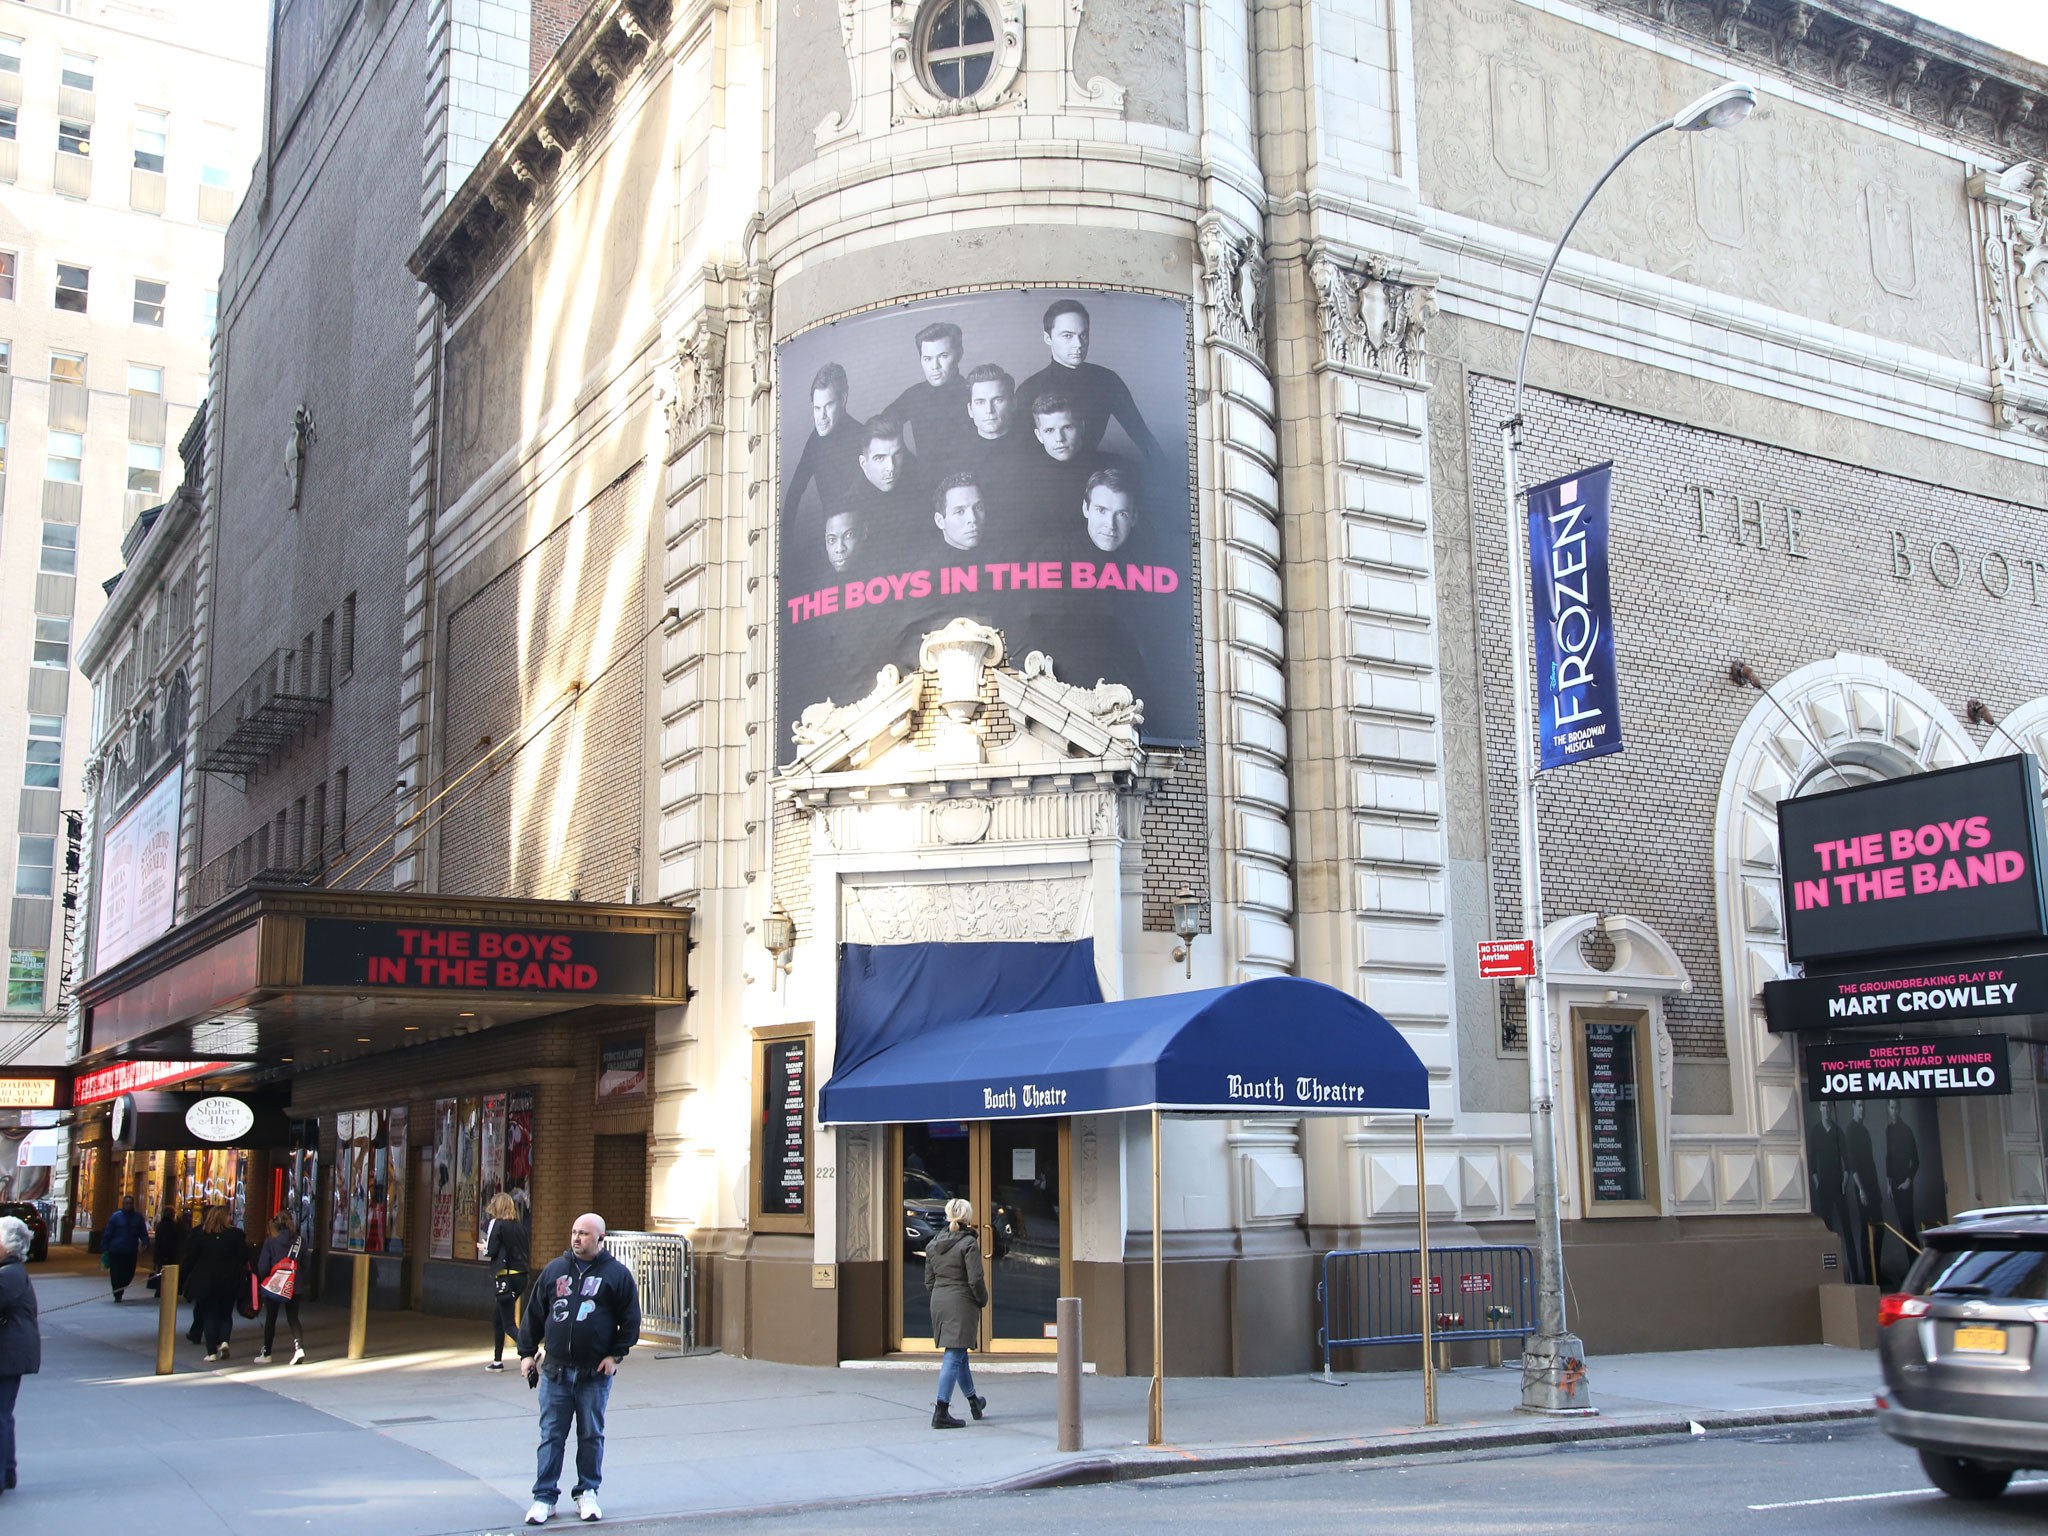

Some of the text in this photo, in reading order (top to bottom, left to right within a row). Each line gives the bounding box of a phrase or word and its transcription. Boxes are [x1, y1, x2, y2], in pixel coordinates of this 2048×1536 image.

[1685, 484, 1810, 559] THE
[788, 562, 1179, 624] THE BOYS IN THE BAND
[1548, 503, 1603, 730] FROZEN
[1553, 724, 1607, 747] THE BROADWAY
[1564, 740, 1595, 755] MUSICAL
[1813, 815, 1992, 872] THE BOYS
[1793, 850, 2026, 911] IN THE BAND
[397, 928, 573, 962] THE BOYS
[1481, 944, 1525, 953] NO STANDING
[1481, 953, 1510, 962] Anytime
[367, 956, 599, 990] IN THE BAND
[1838, 970, 2004, 995] THE GROUNDBREAKING PLAY BY
[1828, 983, 2018, 1018] MART CROWLEY
[1821, 1060, 1871, 1072] TWO-TIME
[1873, 1058, 1902, 1069] TONY
[1946, 1053, 1992, 1064] WINNER
[1869, 1045, 1936, 1059] DIRECTED BY
[1226, 1073, 1366, 1103] Booth Theatre
[1821, 1066, 1996, 1094] JOE MANTELLO
[206, 1099, 232, 1108] One
[982, 1084, 1067, 1110] Booth Theatre
[196, 1107, 240, 1116] Shubert
[199, 1115, 236, 1125] Alley
[815, 1168, 835, 1178] 222
[580, 1276, 602, 1297] H
[576, 1299, 596, 1321] P
